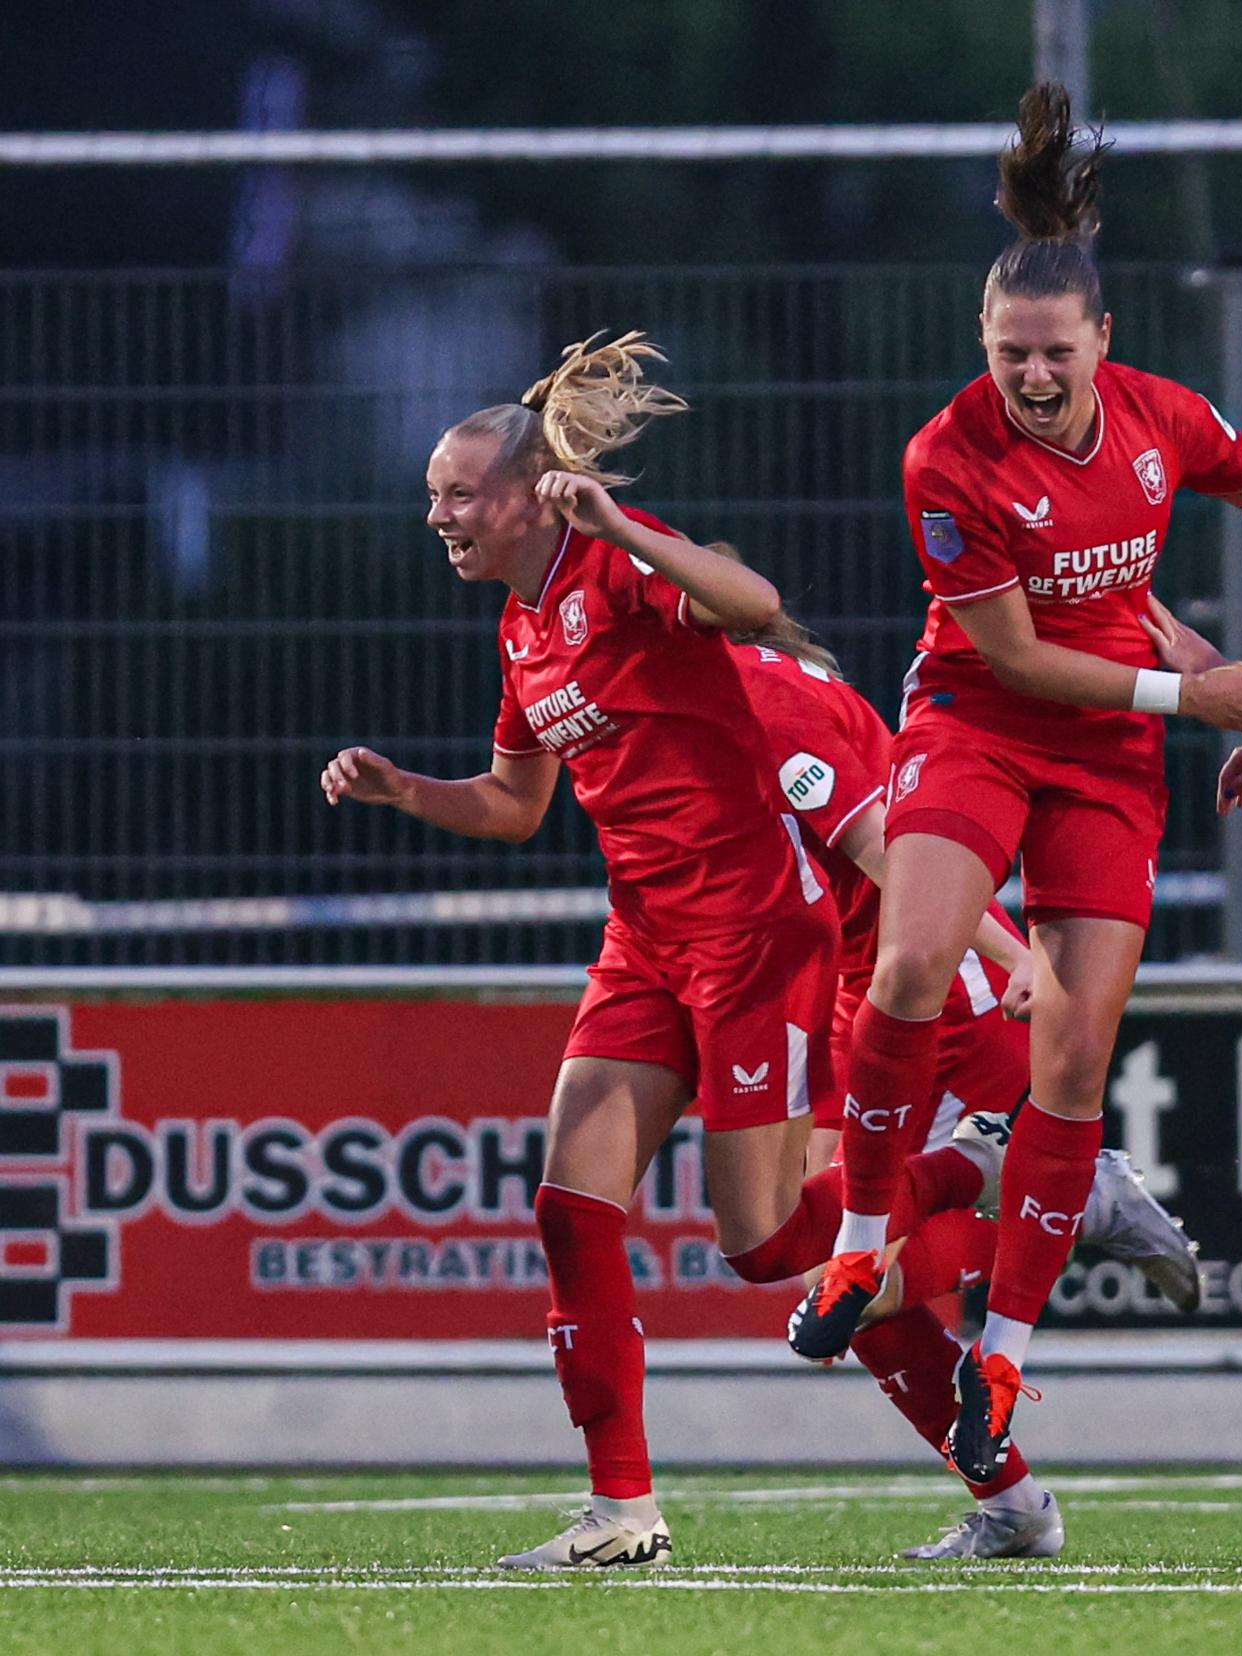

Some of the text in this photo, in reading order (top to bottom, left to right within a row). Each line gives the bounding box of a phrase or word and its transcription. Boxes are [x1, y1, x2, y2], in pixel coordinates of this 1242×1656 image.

[1054, 529, 1157, 576] FUTURE
[1028, 575, 1055, 595] OF
[1056, 551, 1158, 597] TWENTE
[524, 680, 587, 731] FUTURE
[787, 763, 826, 803] TOTO
[842, 1092, 912, 1131] FCT
[1020, 1194, 1085, 1236] FCT
[257, 1239, 549, 1281] BESTRATIN
